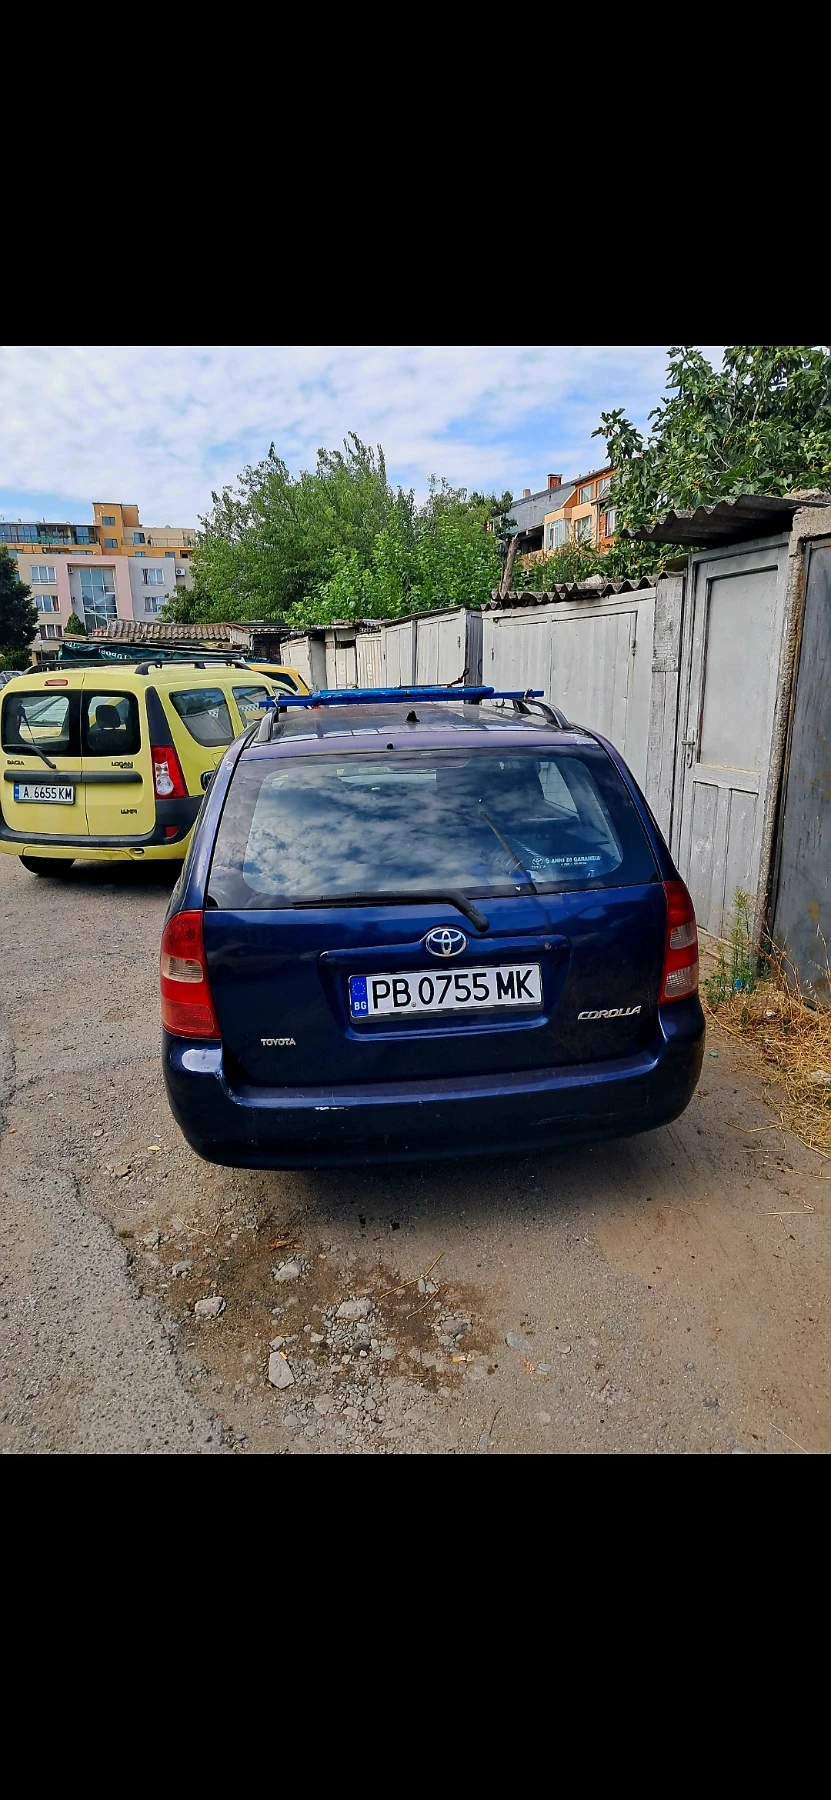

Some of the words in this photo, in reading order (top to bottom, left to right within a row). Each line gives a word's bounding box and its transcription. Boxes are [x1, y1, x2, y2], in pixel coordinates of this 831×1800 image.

[34, 787, 57, 799] 6655
[372, 979, 411, 1009] PB
[418, 973, 490, 1004] 0755
[496, 970, 534, 1000] MK
[354, 1001, 367, 1011] BG
[578, 1005, 641, 1020] COROLLA
[260, 1038, 296, 1046] TOYOTA
